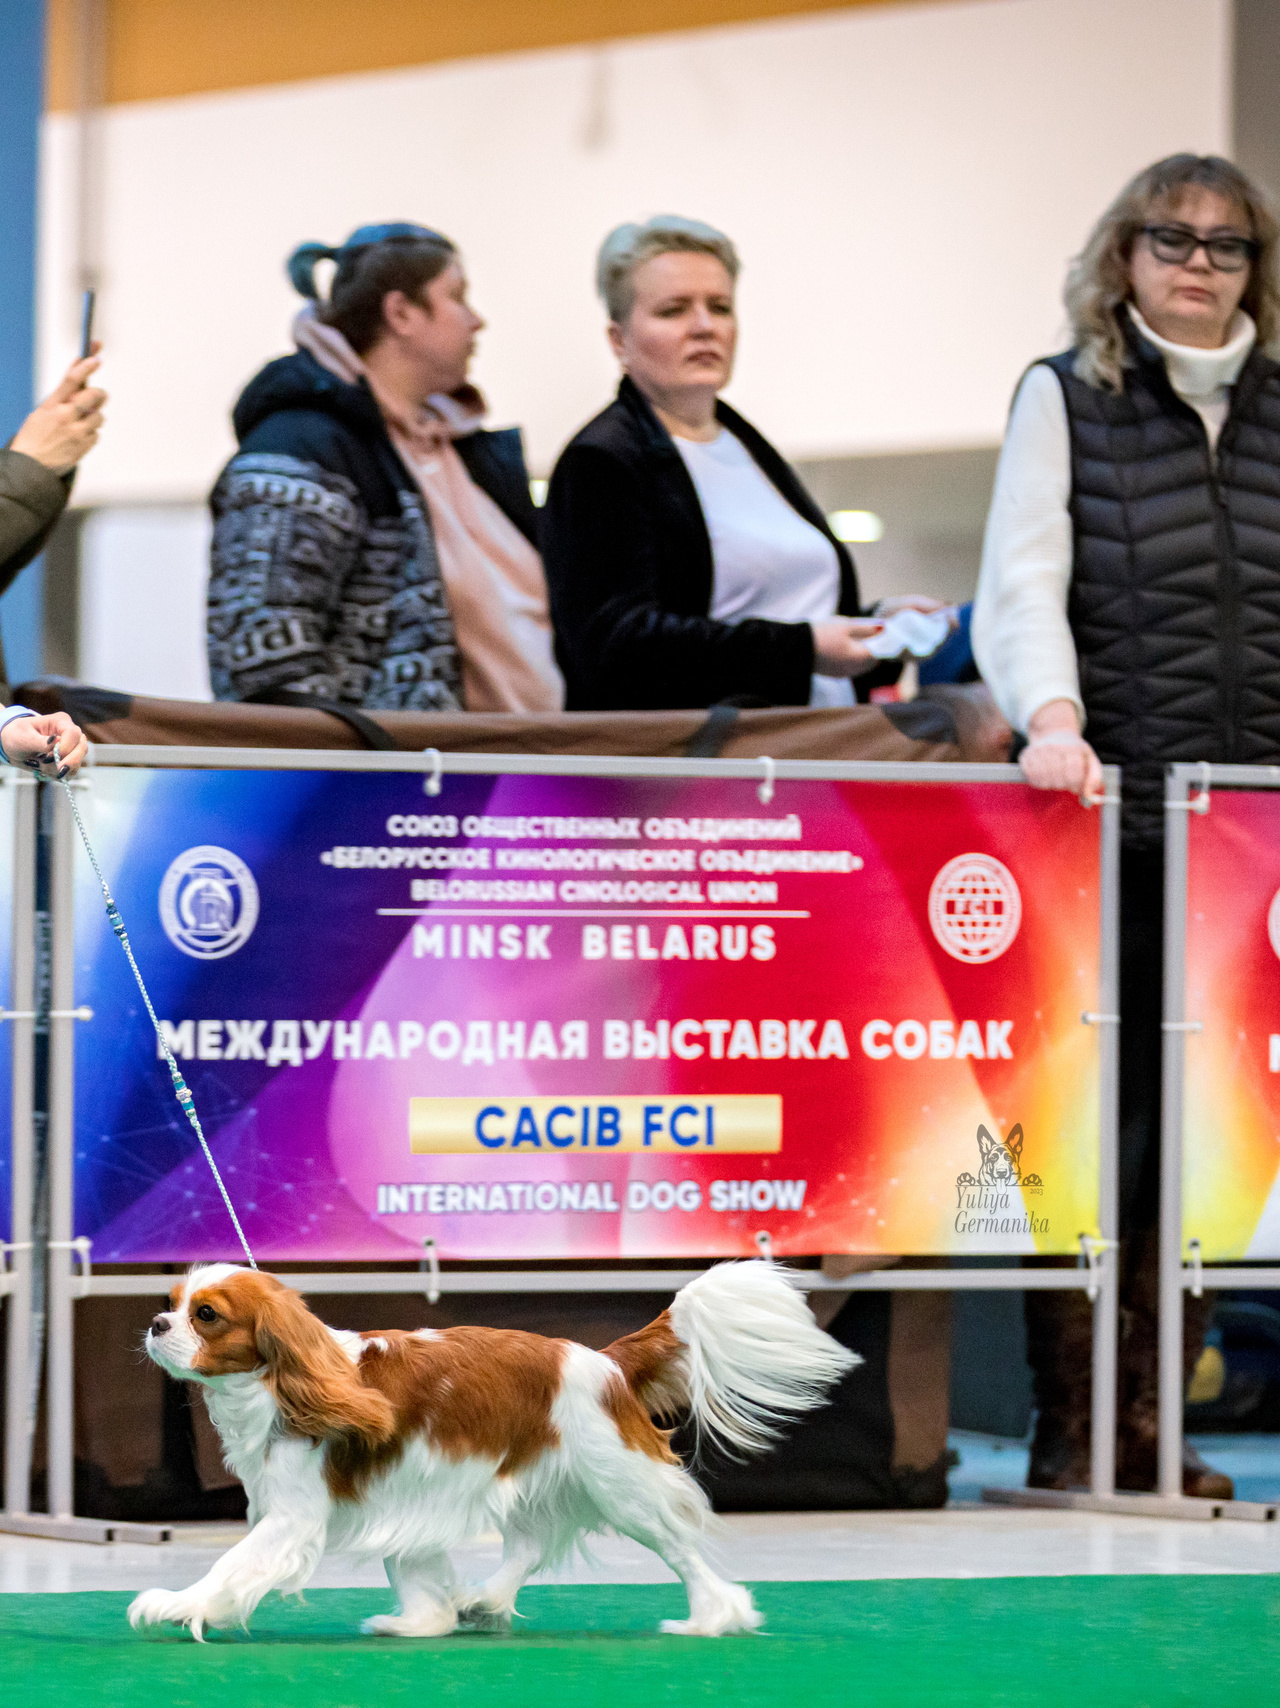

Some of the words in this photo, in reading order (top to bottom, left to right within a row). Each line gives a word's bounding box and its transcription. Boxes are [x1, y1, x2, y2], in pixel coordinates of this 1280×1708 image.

[386, 814, 458, 837] СОЮЗ
[411, 879, 554, 901] BELORUSSIAN
[559, 880, 705, 903] CINOLOGICAL
[707, 881, 778, 903] UNION
[413, 924, 552, 960] MINSK
[582, 924, 777, 961] BELARUS
[157, 1019, 589, 1066] МЕЖДУНАРОДНАЯ
[604, 1019, 849, 1060] ВЫСТАВКА
[861, 1020, 1014, 1060] СОБАК
[475, 1105, 621, 1148] CACIB
[642, 1104, 715, 1147] FCI
[377, 1183, 618, 1215] INTERNATIONAL
[629, 1181, 701, 1212] DOG
[710, 1179, 806, 1211] SHOW
